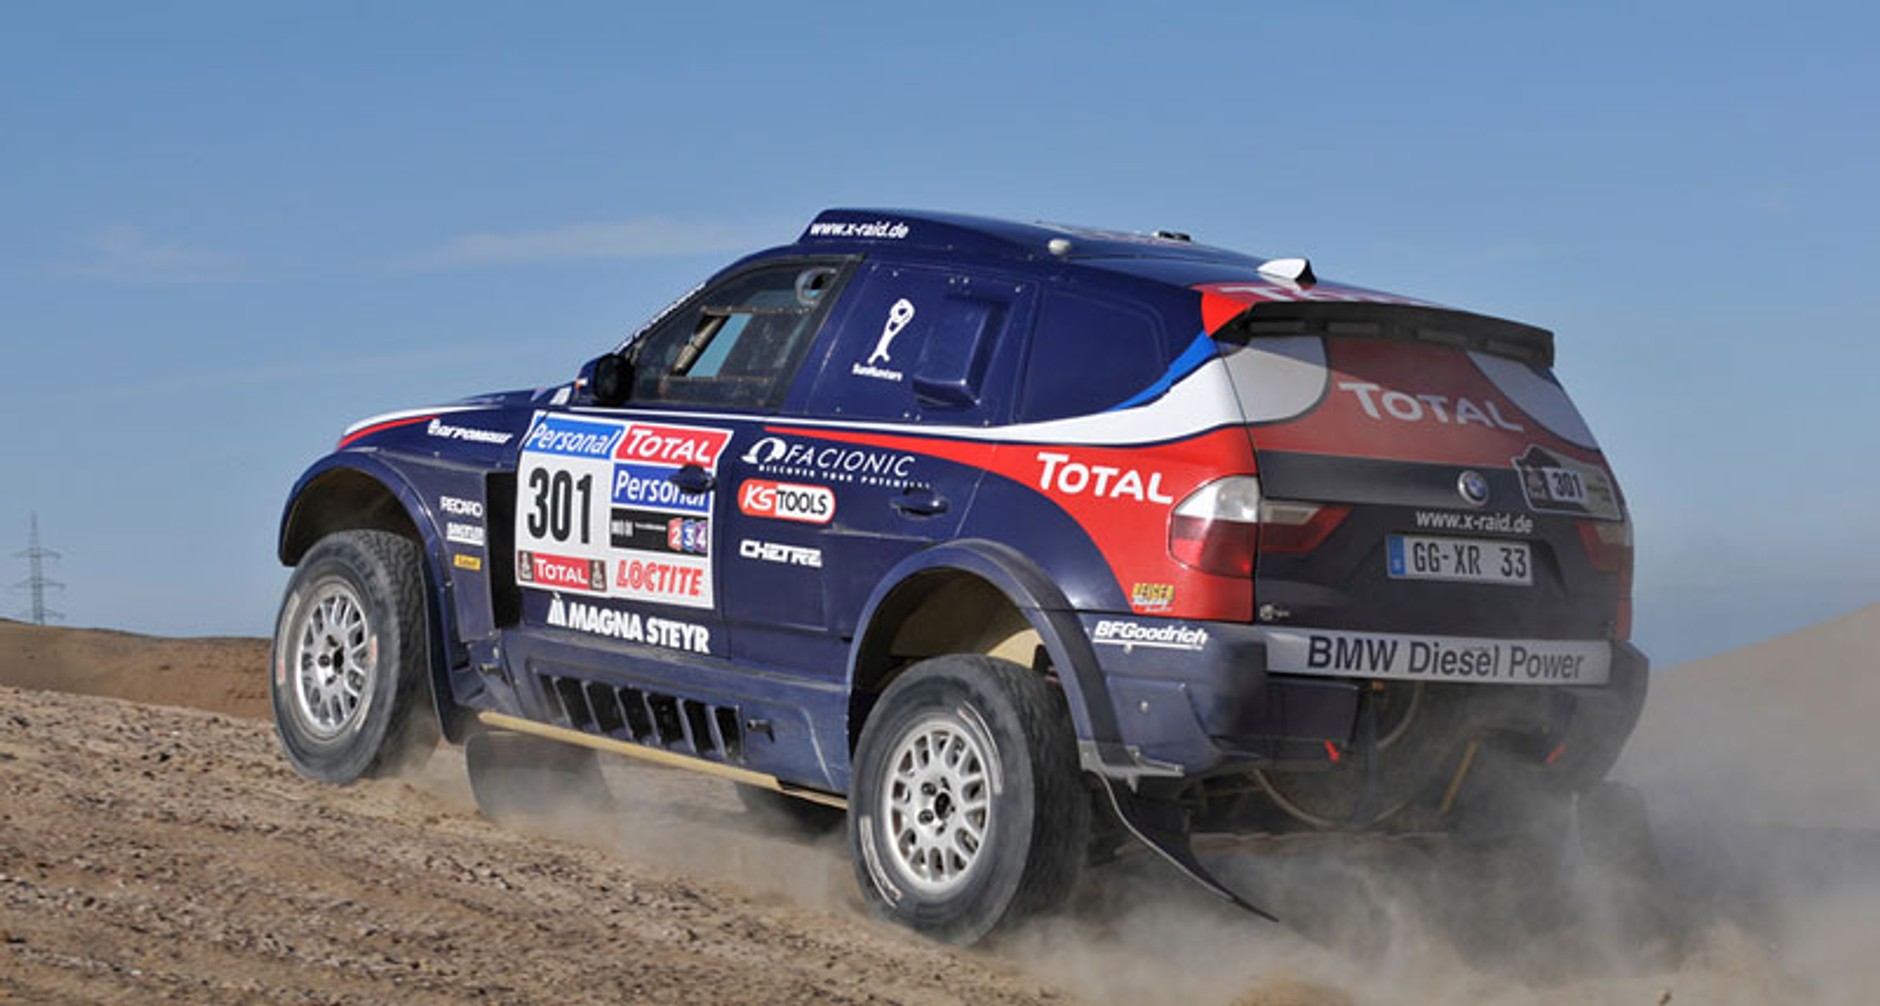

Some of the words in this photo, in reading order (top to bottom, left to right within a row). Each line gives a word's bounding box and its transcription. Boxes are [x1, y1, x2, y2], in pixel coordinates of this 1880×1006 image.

[811, 221, 909, 238] www.x-raid.de
[1336, 382, 1524, 432] TOTAL
[525, 422, 622, 455] Personal
[626, 429, 711, 462] TOTAL
[784, 444, 916, 477] FACIONIC
[1036, 451, 1174, 505] TOTAL
[1552, 471, 1584, 499] 301
[527, 467, 594, 544] 301
[1415, 511, 1534, 533] www.x-raid.de
[533, 558, 589, 584] TOTAL
[616, 558, 703, 597] LOCTITE
[1500, 548, 1527, 578] 33
[568, 601, 644, 641] MAGNA
[645, 616, 711, 654] STEYR
[1093, 620, 1208, 645] BFGoodrich
[1305, 635, 1399, 672] BMW
[1407, 641, 1500, 676] Diesel
[1508, 645, 1586, 678] Power
